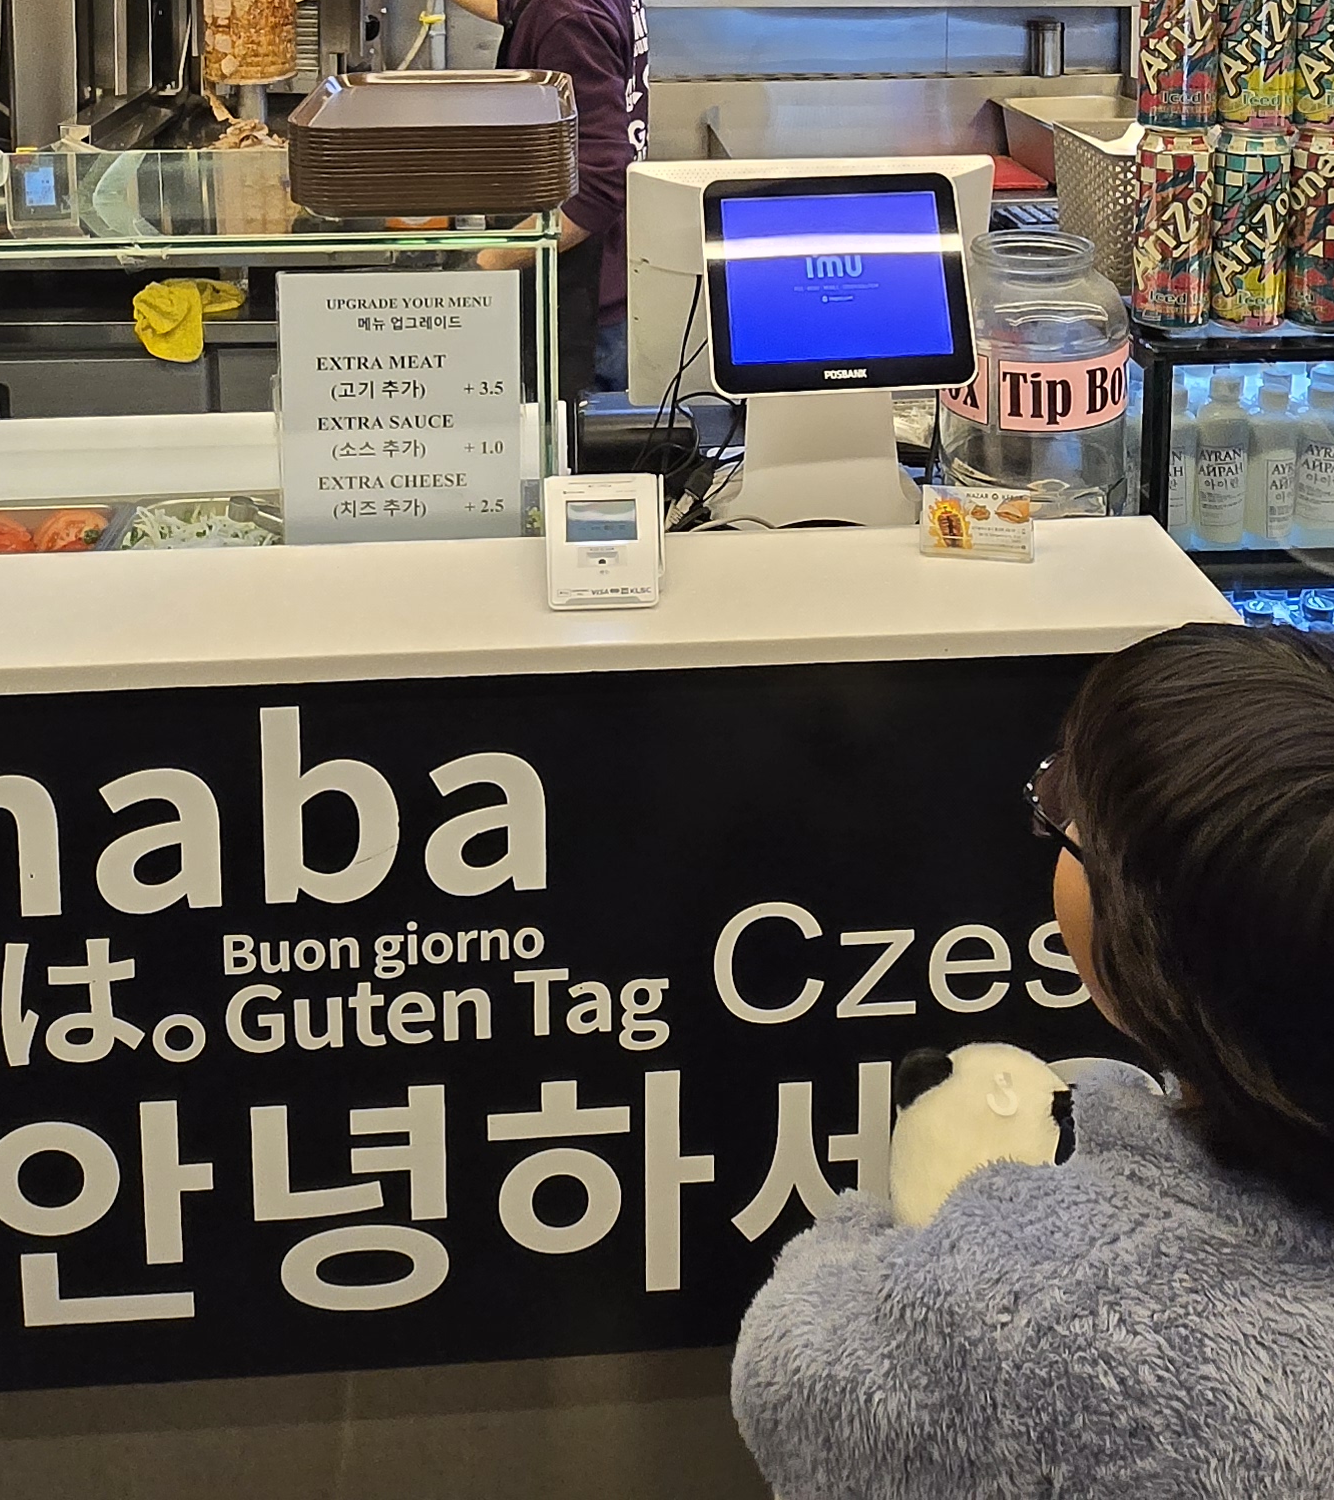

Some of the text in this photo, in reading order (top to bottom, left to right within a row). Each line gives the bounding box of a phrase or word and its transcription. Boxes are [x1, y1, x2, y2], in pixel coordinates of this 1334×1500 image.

[326, 296, 492, 310] UPGRADE YOUR MENU
[357, 316, 462, 331] 메뉴 업그레이드
[316, 355, 446, 371] EXTRA MEAT
[824, 369, 867, 380] POSBANK
[330, 380, 504, 401] (고기 추가) 3.5
[1003, 371, 1072, 425] Tip
[318, 414, 454, 431] EXTRA SAUCE
[332, 440, 504, 460] (소스 추가) 1.0
[1199, 448, 1242, 462] AYRAN
[318, 473, 468, 491] EXTRA CHEESE
[333, 499, 504, 519] (치즈 추가) 2.5
[222, 922, 546, 979] Buon giorno
[224, 967, 670, 1054] Guten Tag
